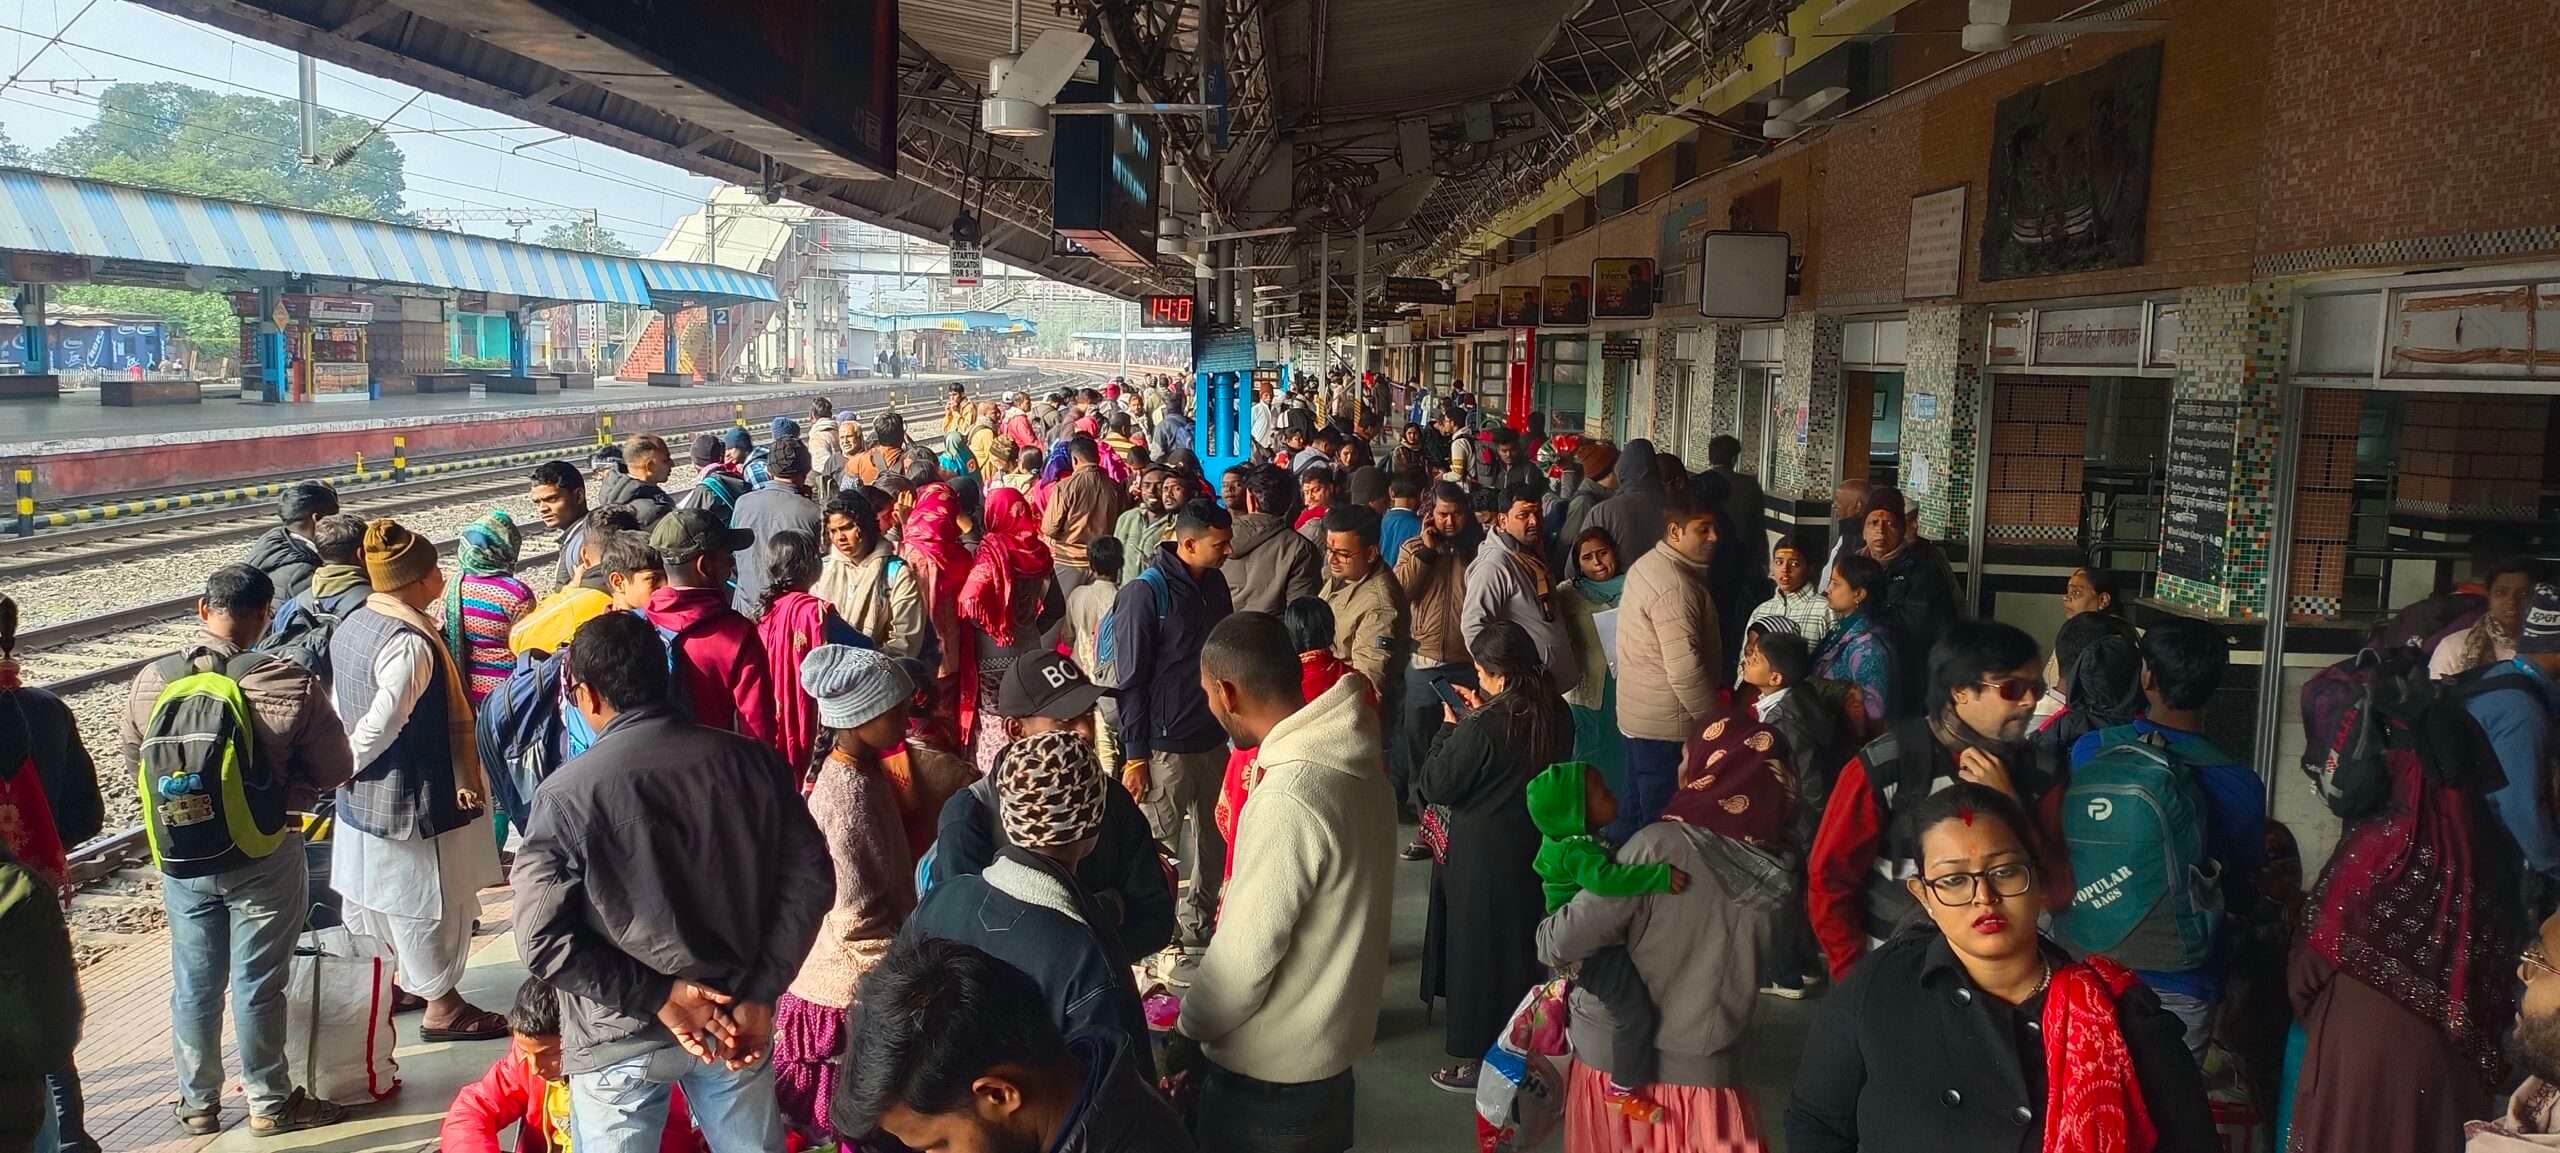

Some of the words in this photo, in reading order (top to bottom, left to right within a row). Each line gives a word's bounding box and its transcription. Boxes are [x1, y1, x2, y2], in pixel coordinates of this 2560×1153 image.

[953, 252, 980, 260] STARTER
[953, 261, 980, 269] INDICATOR
[952, 269, 965, 277] FOR
[1152, 298, 1193, 322] 14:0
[716, 310, 727, 324] 2
[2090, 887, 2123, 910] BAGS
